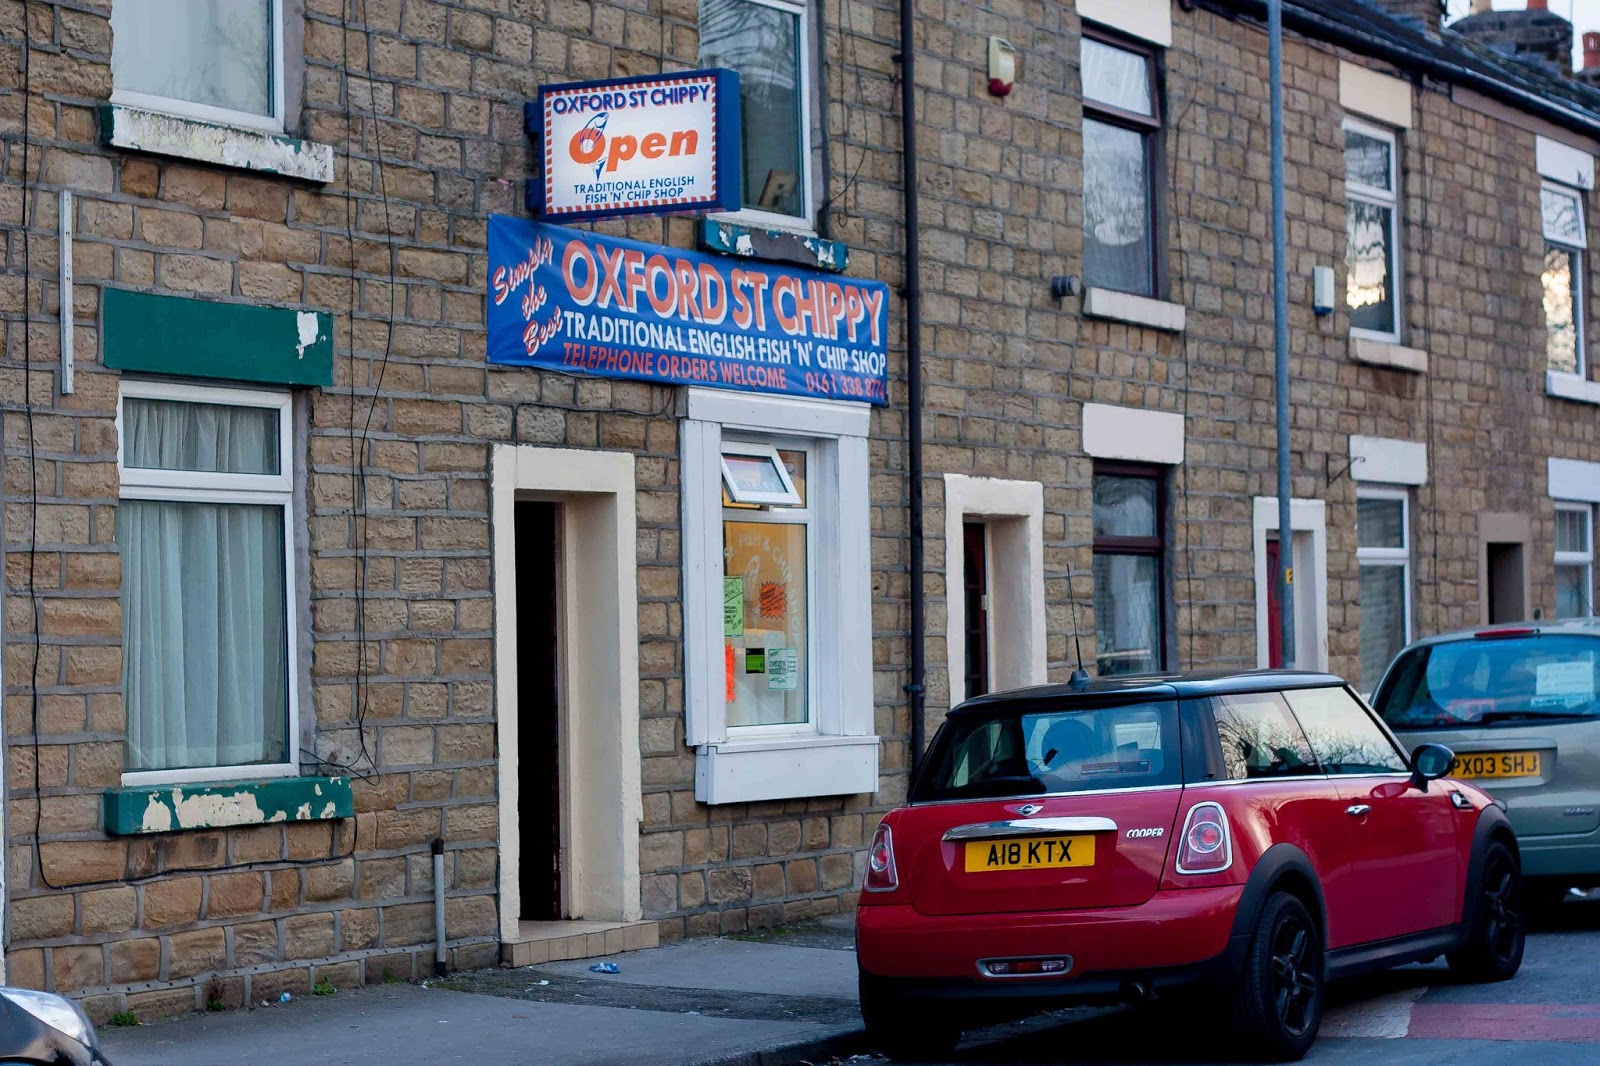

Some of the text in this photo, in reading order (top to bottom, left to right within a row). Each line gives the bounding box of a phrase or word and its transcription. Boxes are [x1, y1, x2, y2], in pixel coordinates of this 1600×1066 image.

[553, 84, 711, 114] OXFORD ST CHIPPY
[569, 127, 698, 172] Open
[574, 175, 695, 194] TRADITIONAL ENGLISH
[585, 193, 607, 204] FISH
[627, 189, 651, 201] CHIP
[654, 187, 684, 198] SHOP
[493, 235, 554, 305] Simply
[522, 283, 547, 321] the
[561, 239, 884, 346] OXFORD ST CHIPPY
[522, 306, 564, 357] Best
[564, 310, 686, 351] TRADITIONAL
[688, 328, 756, 361] ENGLISH
[759, 338, 791, 365] FISH
[817, 345, 848, 371] CHIP
[851, 349, 886, 376] SHOP
[563, 341, 653, 375] TELEPHONE
[657, 354, 717, 383] ORDERS
[720, 361, 787, 389] WELCOME
[806, 371, 837, 394] 0161
[840, 375, 863, 396] 338
[1502, 755, 1537, 773] SHJ
[1126, 827, 1164, 838] COOPER
[987, 840, 1073, 866] A18 KTX
